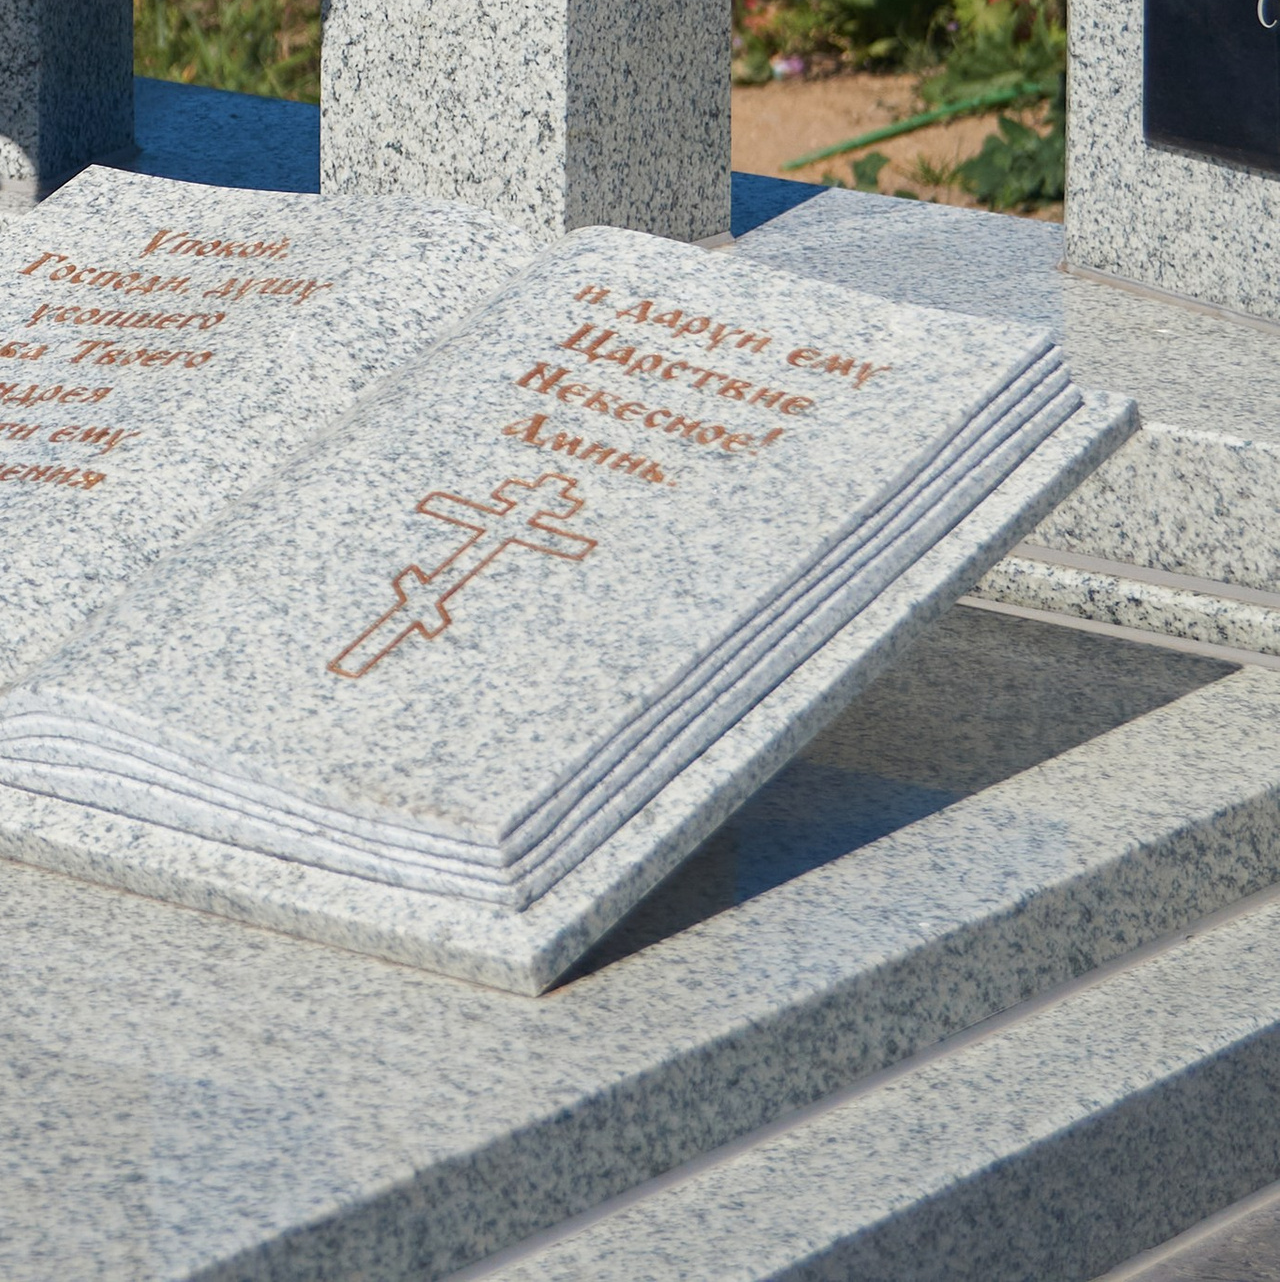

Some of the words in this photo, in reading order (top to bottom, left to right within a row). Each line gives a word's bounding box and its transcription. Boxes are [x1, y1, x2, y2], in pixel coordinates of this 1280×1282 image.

[139, 230, 290, 261] Упокой,
[17, 252, 189, 295] Господи,
[203, 277, 333, 305] душу
[25, 303, 226, 330] усопшего
[69, 340, 213, 368] Твоего
[559, 322, 816, 416] Царствие
[786, 347, 892, 390] ему
[513, 361, 785, 457] Небесное!
[49, 425, 141, 455] ему
[500, 413, 677, 487] Аминь.
